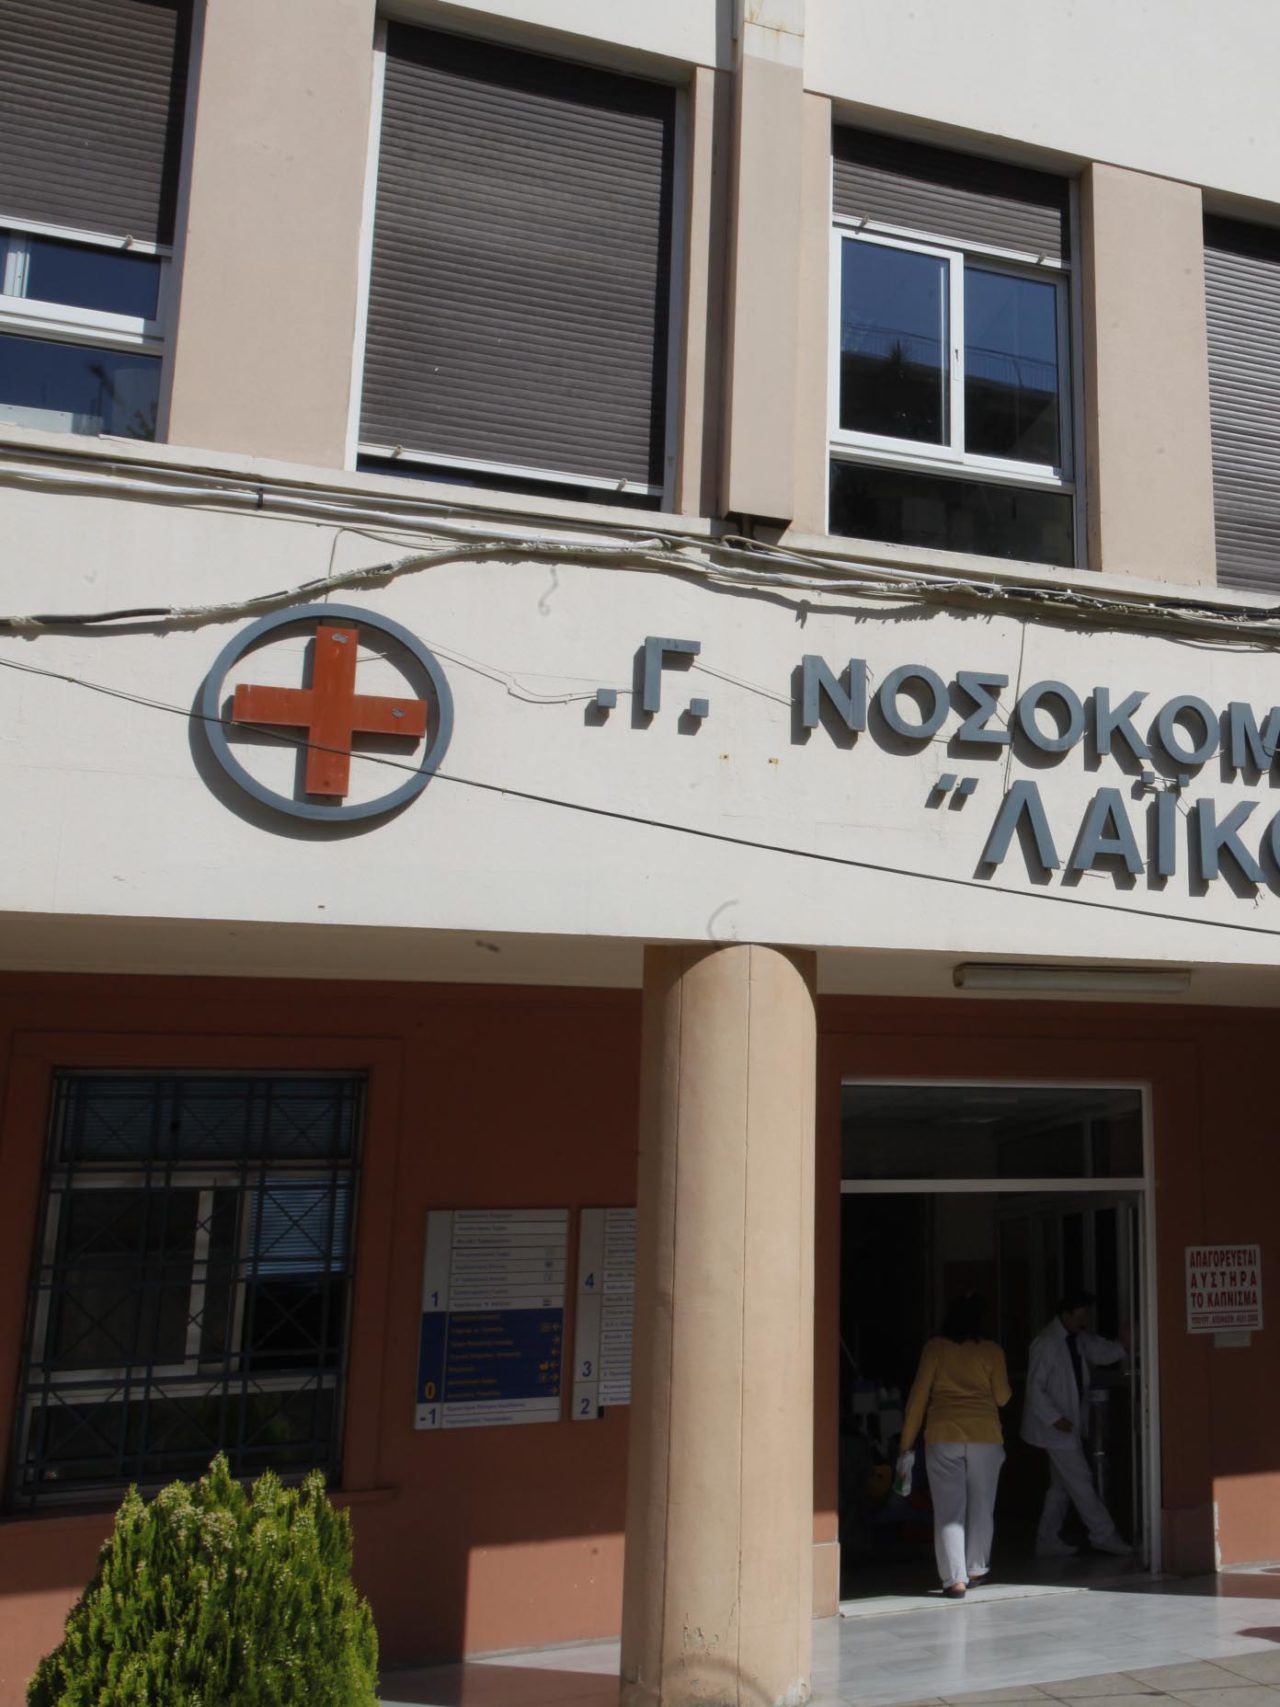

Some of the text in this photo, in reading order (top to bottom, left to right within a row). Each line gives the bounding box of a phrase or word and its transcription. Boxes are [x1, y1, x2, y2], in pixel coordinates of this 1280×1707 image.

[1190, 1249, 1257, 1268] ΑΠΑΓΟΡΕΥΕΤΑΙ
[585, 1272, 595, 1289] 4
[1190, 1270, 1257, 1289] ΑΥΣΤΗΡΑ
[431, 1291, 439, 1307] 1
[1191, 1291, 1257, 1308] ΤΟ ΚΑΠΝΙΣΜΑ
[582, 1360, 592, 1377] 3
[424, 1381, 436, 1400] 0
[580, 1398, 590, 1415] 2
